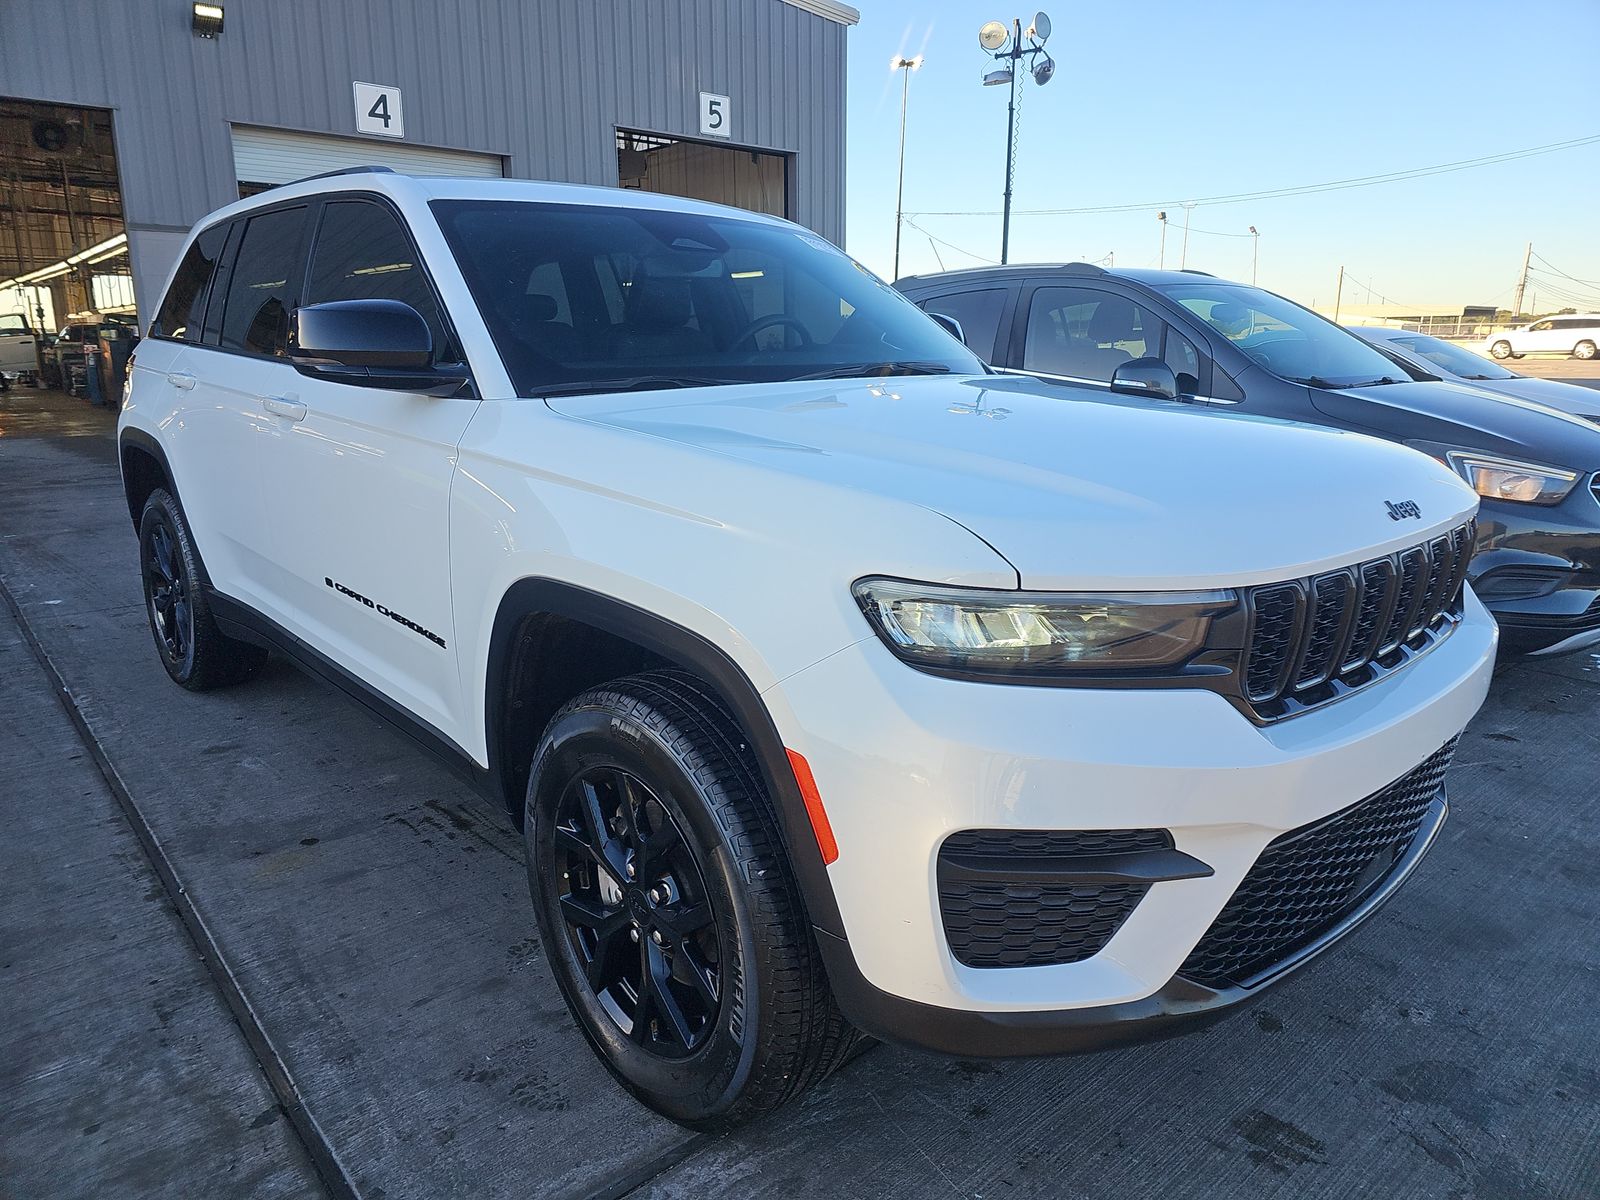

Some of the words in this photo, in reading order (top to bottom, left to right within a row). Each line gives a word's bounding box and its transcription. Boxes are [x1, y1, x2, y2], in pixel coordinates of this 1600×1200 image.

[368, 94, 391, 128] 4
[709, 100, 722, 128] 5
[1384, 500, 1421, 521] Jeep
[335, 583, 374, 608] GRAND
[376, 604, 447, 649] CHEROKEE
